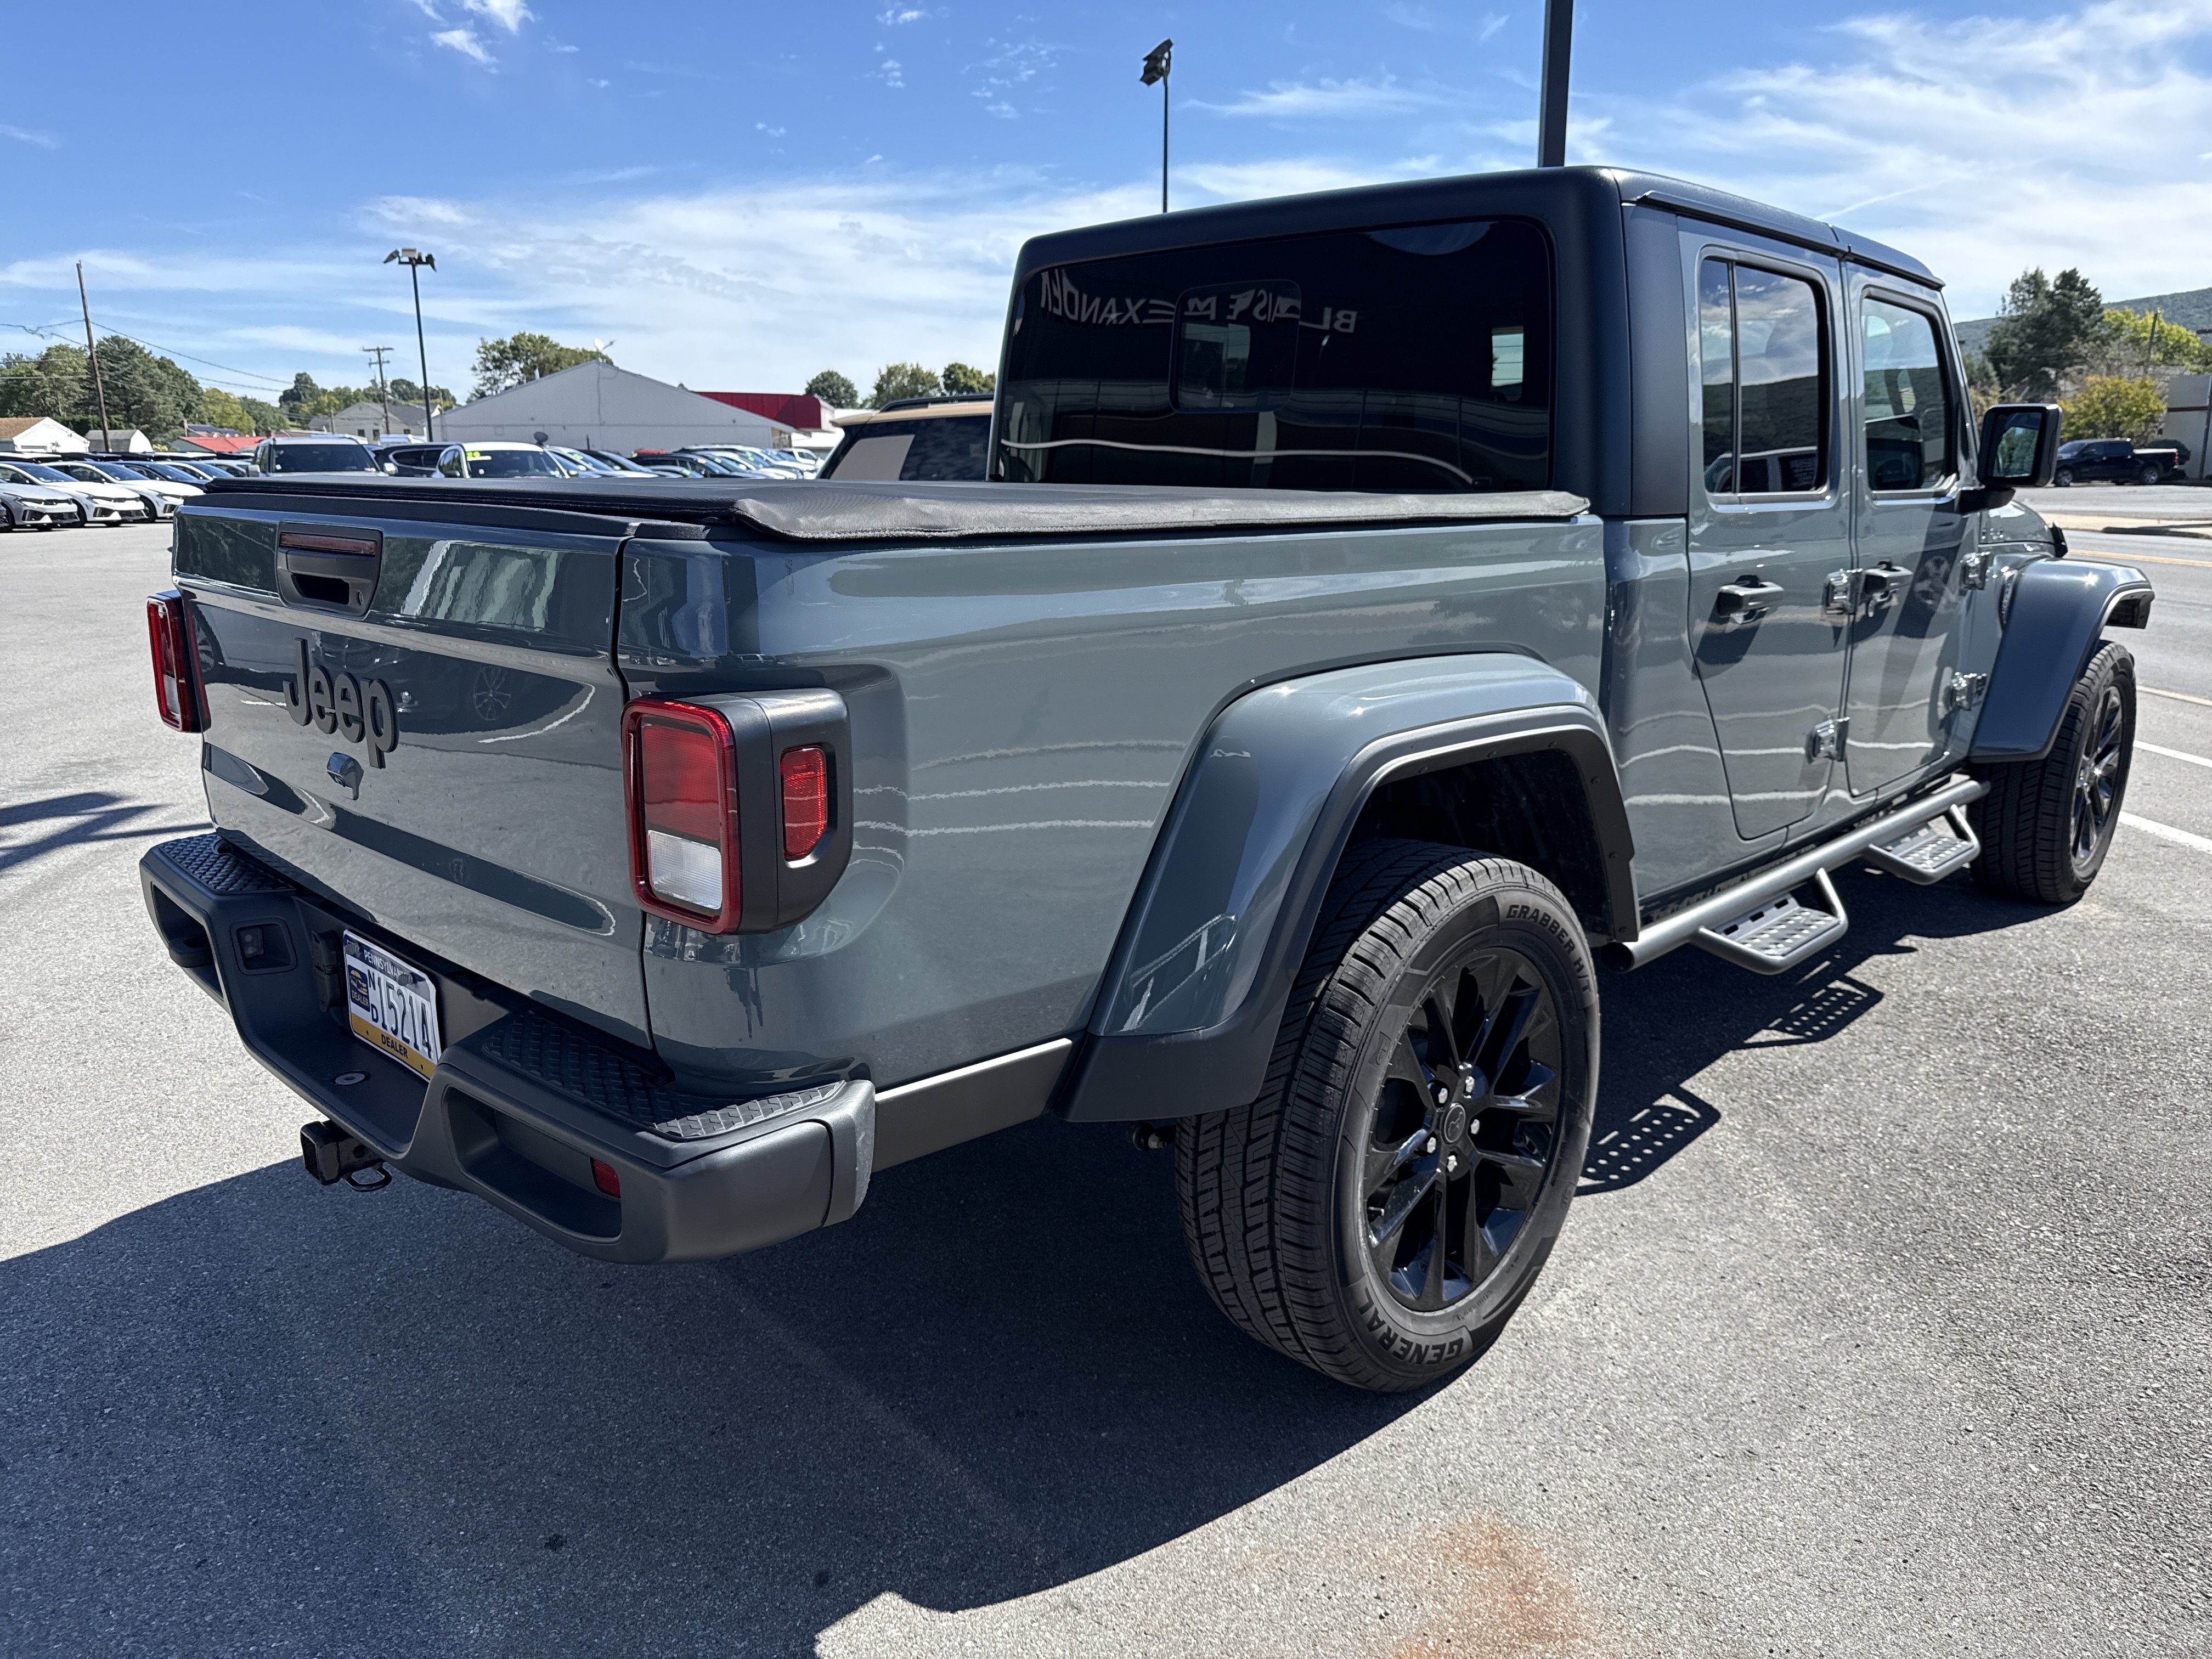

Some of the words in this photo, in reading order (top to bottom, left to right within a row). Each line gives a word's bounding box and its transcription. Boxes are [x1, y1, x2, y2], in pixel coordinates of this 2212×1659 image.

[283, 637, 399, 769] Jeep
[364, 949, 405, 978] PENNSYLVAN
[1505, 904, 1576, 955] GRABBER
[1573, 956, 1592, 992] H/T
[351, 990, 369, 1007] DEALER
[381, 1033, 408, 1059] DEALER
[1358, 1286, 1464, 1365] GENERAL
